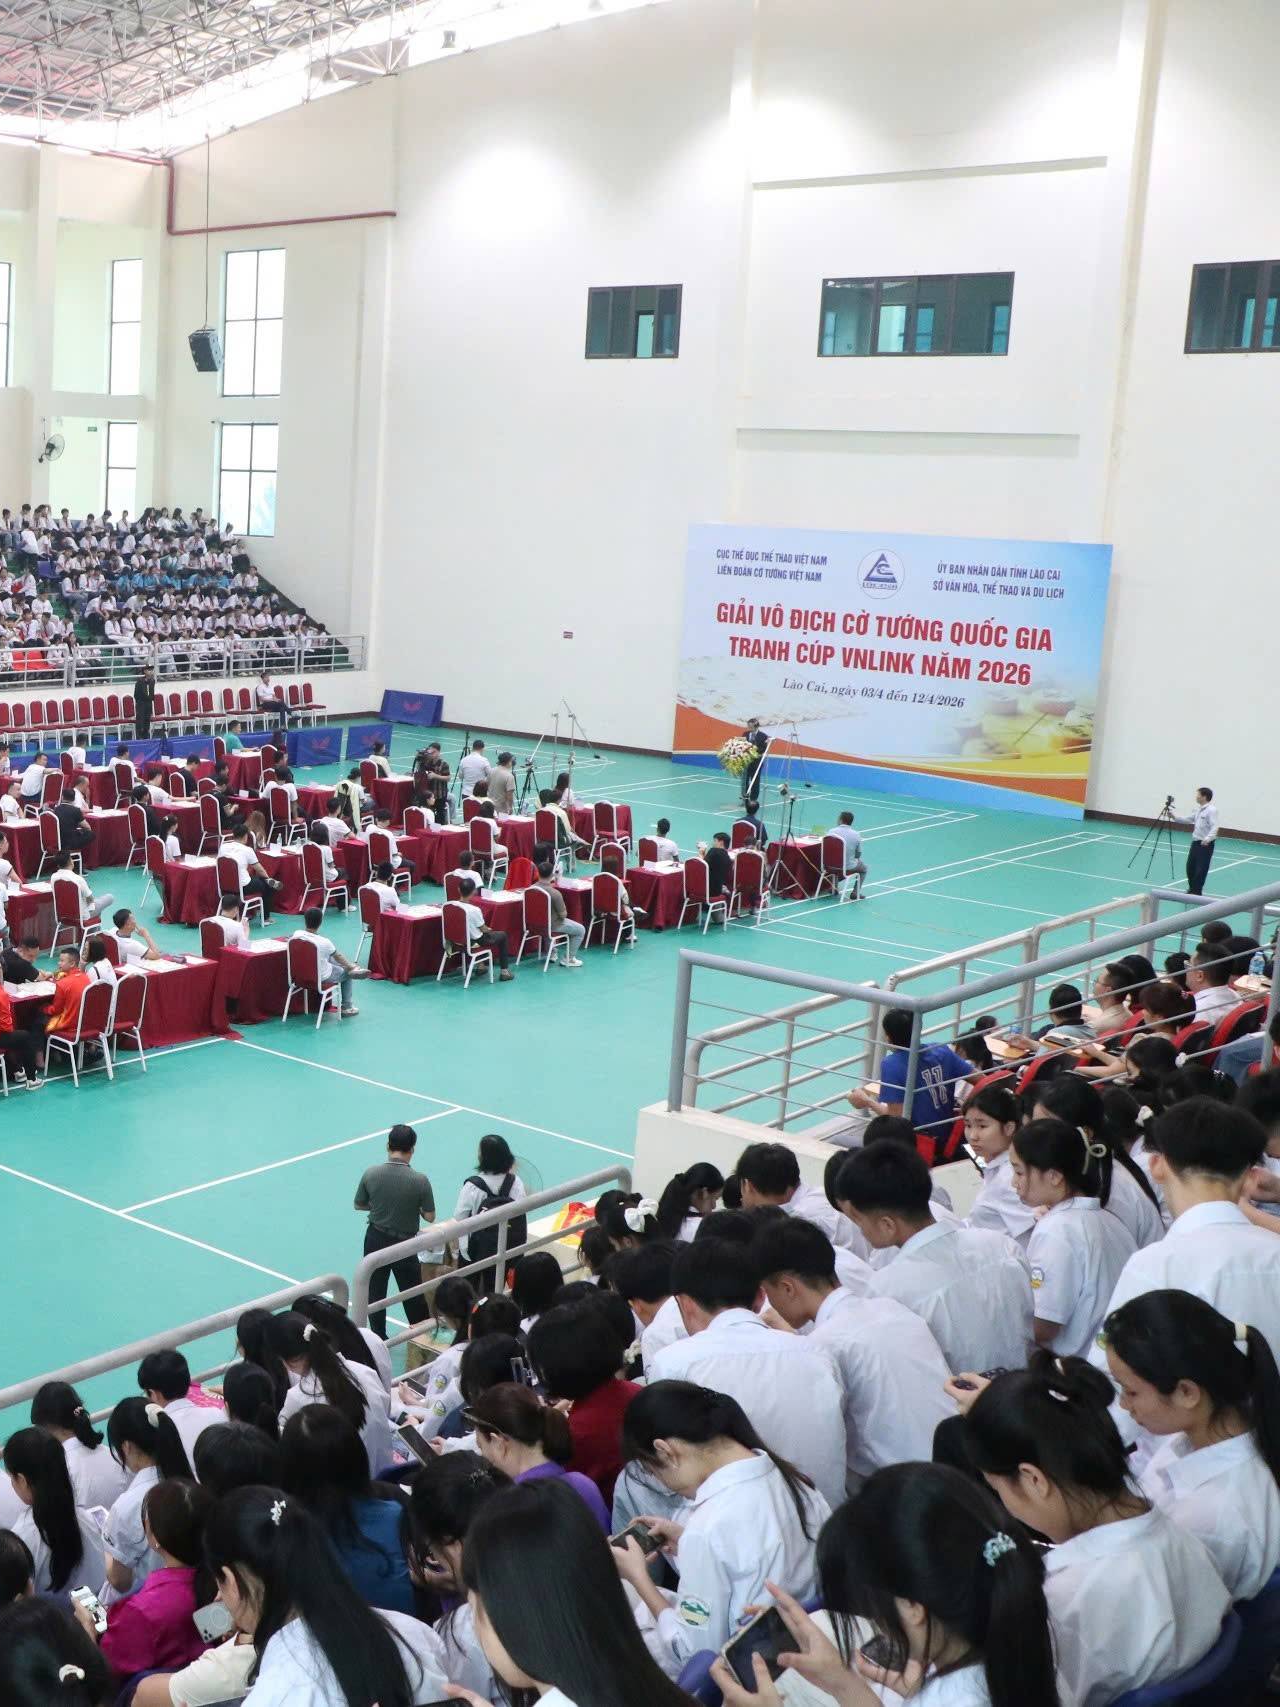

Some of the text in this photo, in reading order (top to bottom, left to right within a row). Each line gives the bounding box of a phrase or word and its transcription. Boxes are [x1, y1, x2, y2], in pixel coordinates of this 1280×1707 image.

[775, 553, 792, 563] THAO
[810, 556, 827, 566] NAM
[805, 572, 822, 582] NAM
[949, 565, 965, 575] BAN
[1047, 570, 1061, 580] CAI
[999, 585, 1019, 596] THAO
[1033, 587, 1044, 597] DU
[717, 597, 1052, 651] GIẢI VÔ ĐỊCH CỜ TƯỚNG QUỐC GIA
[729, 636, 1031, 686] TRANH CÚP VNLINK NĂM 2026
[783, 678, 965, 708] Lào Cai, ngày 03/4 đến 12/4/2026
